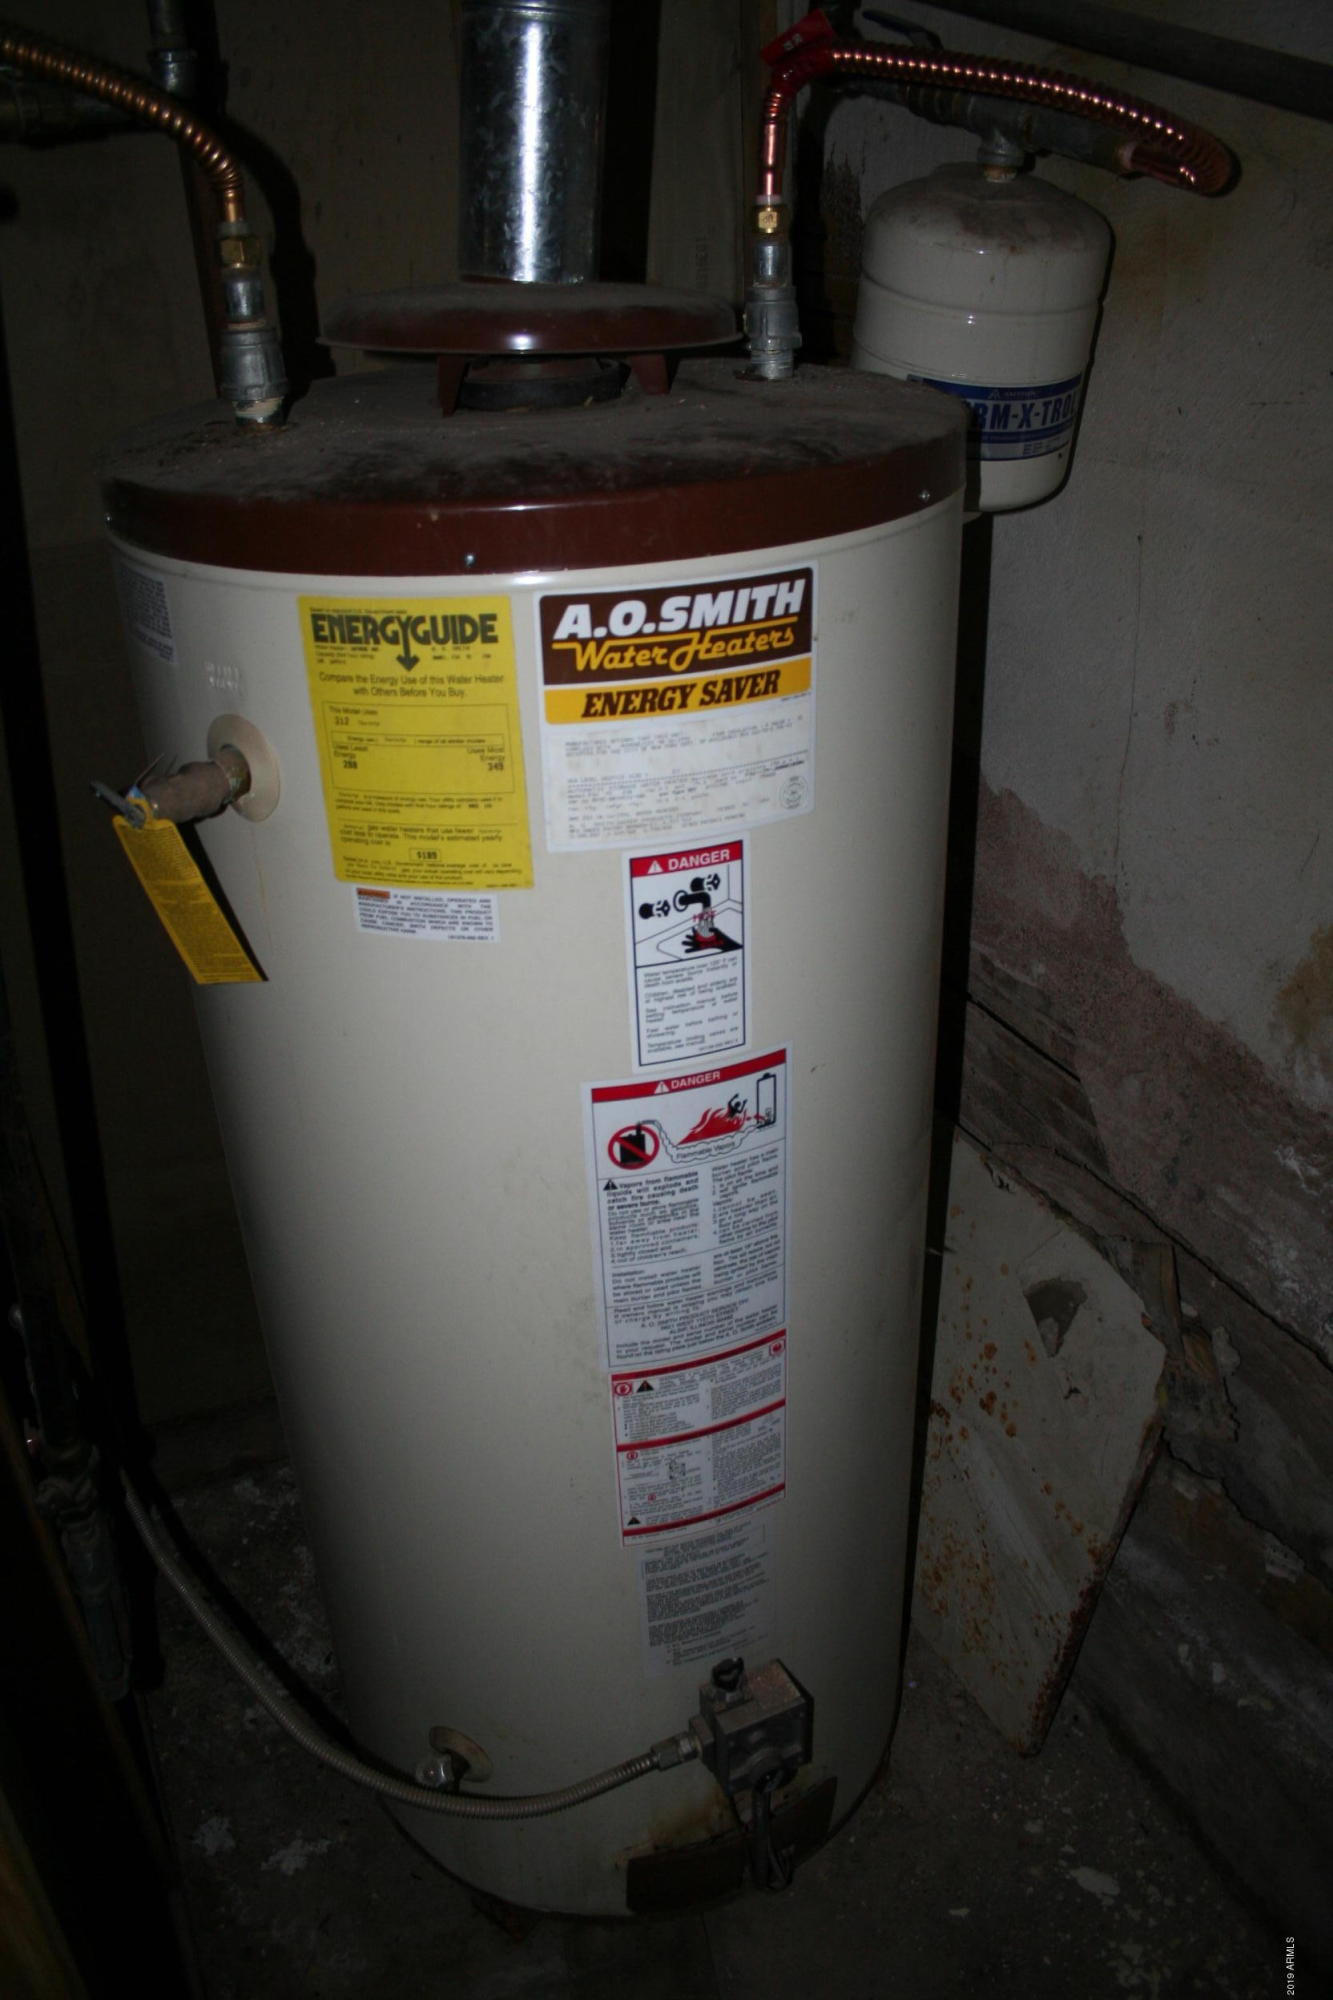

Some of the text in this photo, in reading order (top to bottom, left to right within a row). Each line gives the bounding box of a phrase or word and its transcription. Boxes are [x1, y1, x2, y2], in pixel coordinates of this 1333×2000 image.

[973, 392, 1074, 430] RM-X-TRO
[553, 578, 806, 640] A.O.SMITH
[311, 613, 499, 647] ENERGYGUIDE
[556, 622, 796, 672] Water Heaters
[319, 672, 504, 686] Compare the Energy Use of this Water Heater
[353, 686, 369, 696] with
[370, 686, 398, 696] Others
[400, 686, 426, 697] Before
[429, 687, 446, 697] You
[581, 669, 781, 718] ENERGY SAVER
[668, 849, 730, 871] DANGER
[671, 1071, 721, 1089] DANGER
